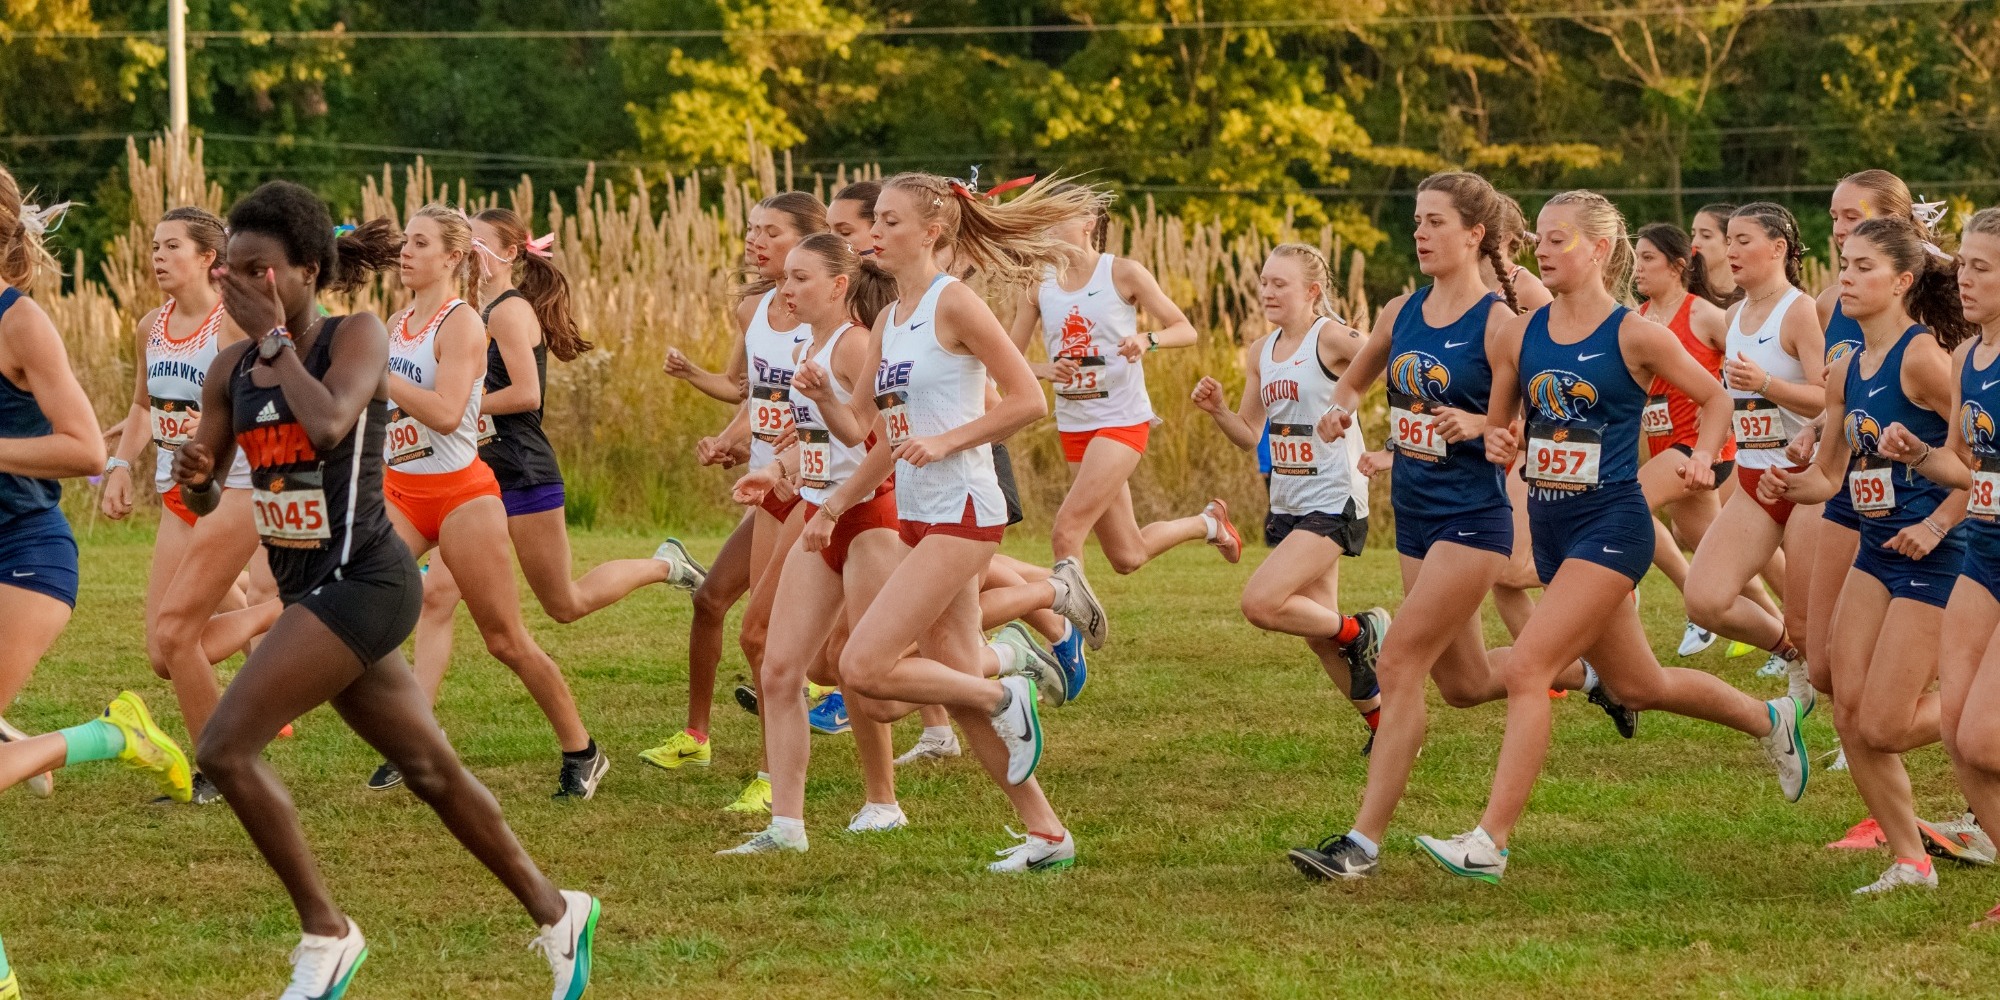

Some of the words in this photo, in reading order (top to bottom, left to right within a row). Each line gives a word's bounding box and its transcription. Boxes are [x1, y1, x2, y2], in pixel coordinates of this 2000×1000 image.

[759, 366, 794, 387] LEE
[878, 361, 914, 392] LEE
[1262, 380, 1299, 408] UNION
[256, 412, 280, 423] adidas
[1740, 416, 1771, 437] 937
[1398, 417, 1435, 447] 961
[1271, 441, 1313, 462] 1018
[1537, 447, 1587, 475] 957
[1535, 480, 1587, 492] CHAMPIONSHIPS
[1854, 477, 1885, 504] 959
[1973, 480, 1993, 507] 58
[255, 500, 323, 531] 1045
